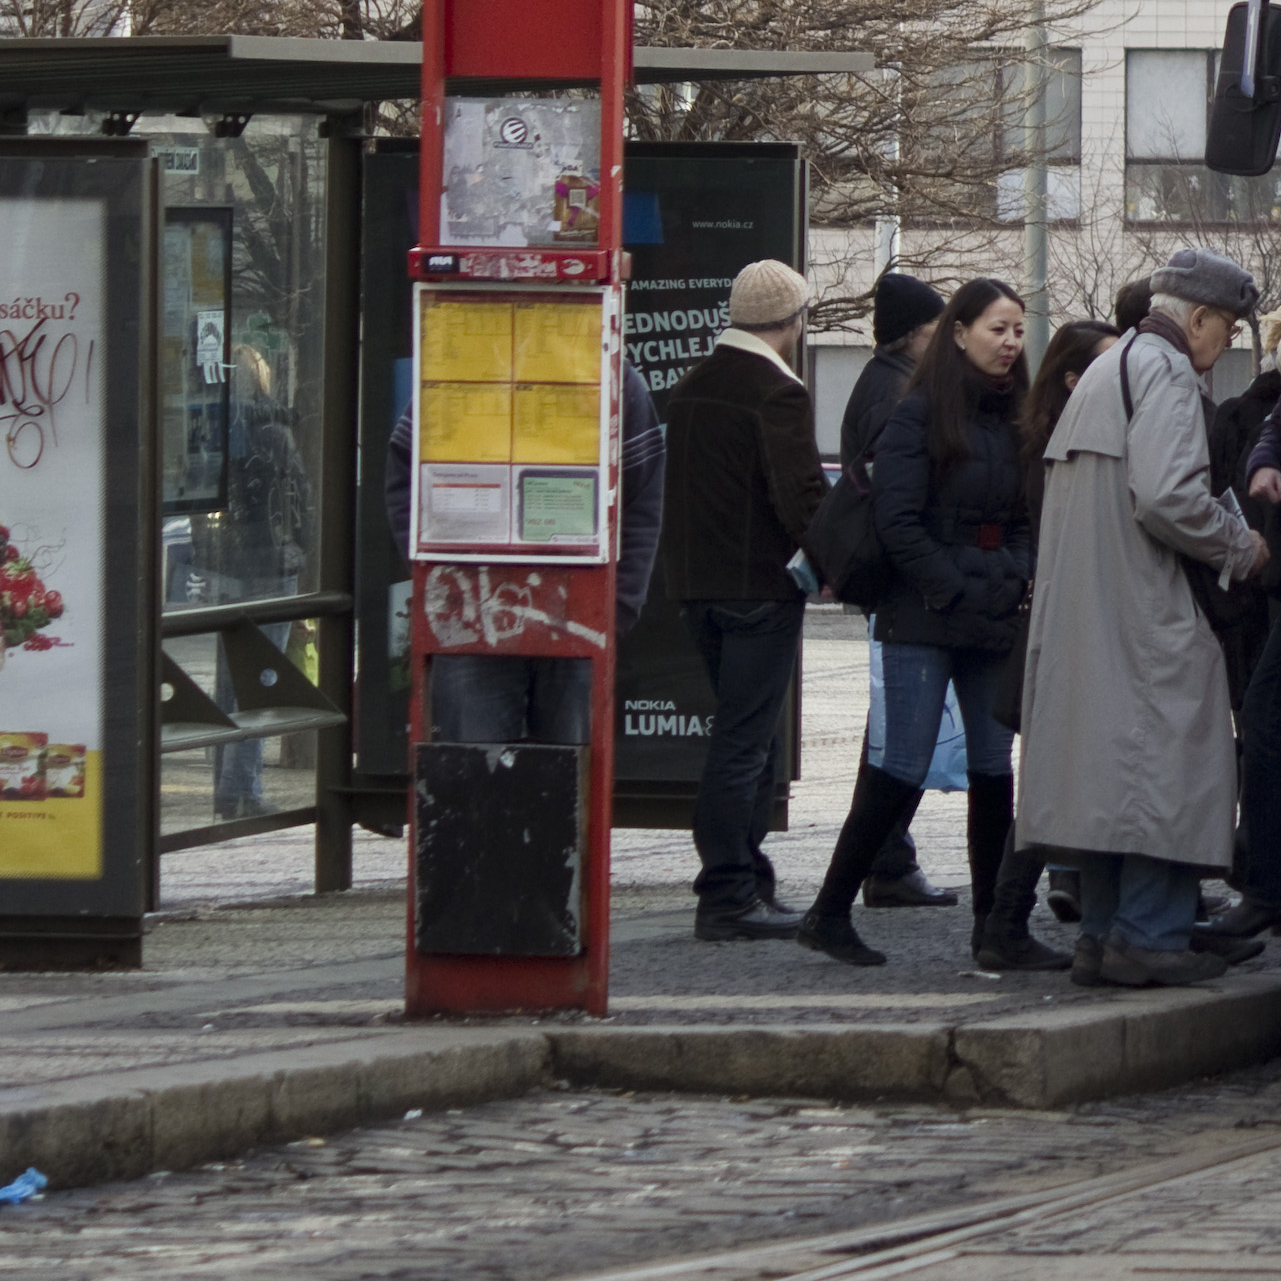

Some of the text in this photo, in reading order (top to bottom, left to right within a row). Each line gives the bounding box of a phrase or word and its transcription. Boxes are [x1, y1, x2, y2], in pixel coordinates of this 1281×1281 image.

[692, 219, 754, 229] www.nokia.cz
[631, 278, 686, 290] AMAZING
[689, 277, 735, 289] EVERYD
[0, 292, 80, 320] sáčku?
[625, 700, 676, 710] NOKIA
[625, 714, 704, 736] LUMIA
